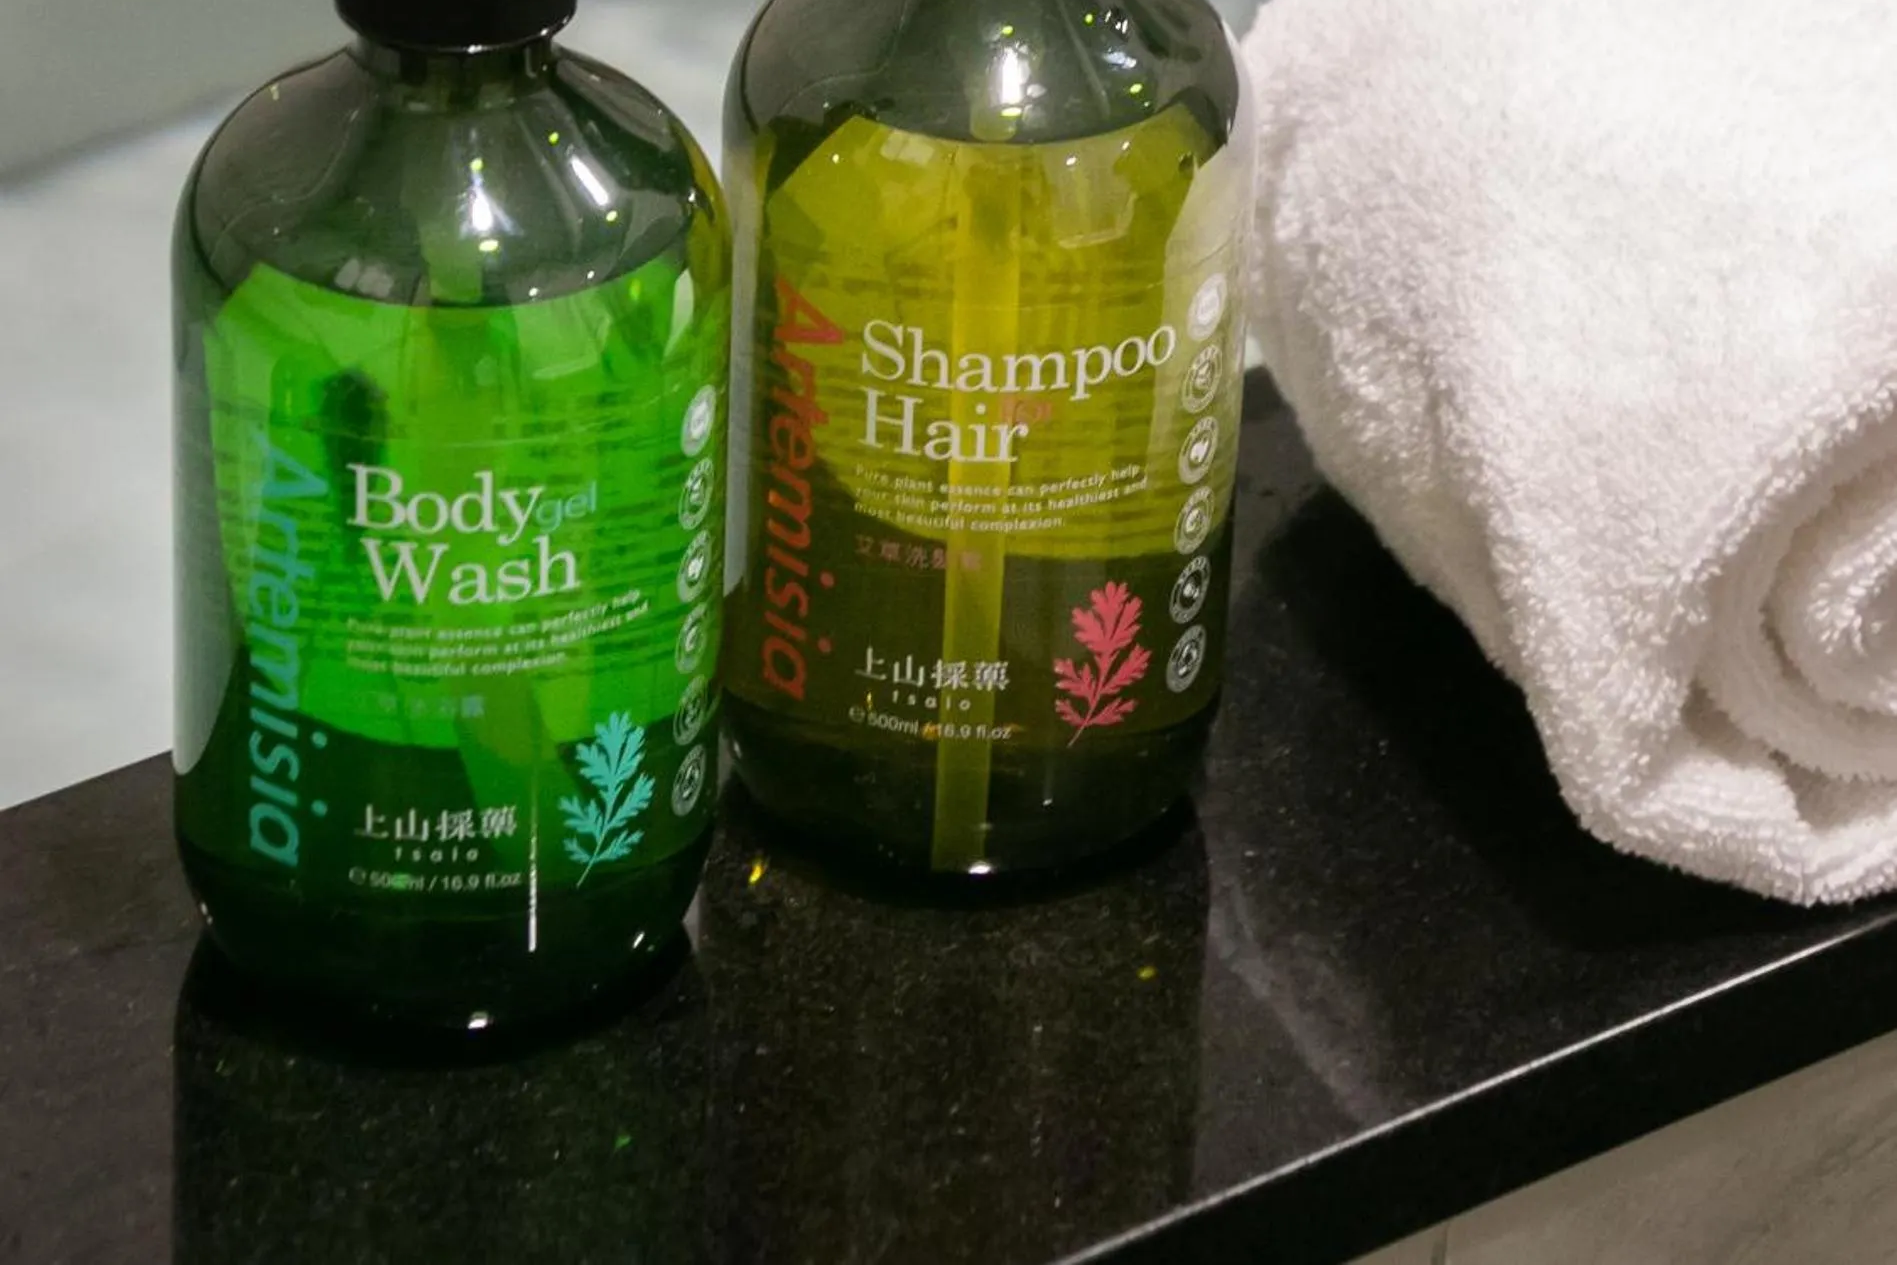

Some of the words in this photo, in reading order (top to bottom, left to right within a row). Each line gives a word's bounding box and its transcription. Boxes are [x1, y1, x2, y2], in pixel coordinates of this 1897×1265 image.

[861, 319, 1177, 402] Shampoo
[858, 385, 1029, 464] Hair
[346, 463, 545, 545] Body
[535, 481, 597, 533] gel
[762, 275, 846, 702] Artemisia
[895, 477, 933, 494] plant
[1008, 485, 1034, 497] can
[1040, 474, 1106, 497] perfectly
[931, 499, 997, 516] perform
[361, 536, 582, 606] Wash
[247, 432, 329, 868] Artemisia
[867, 711, 919, 735] 500ml
[937, 722, 972, 738] 16.9
